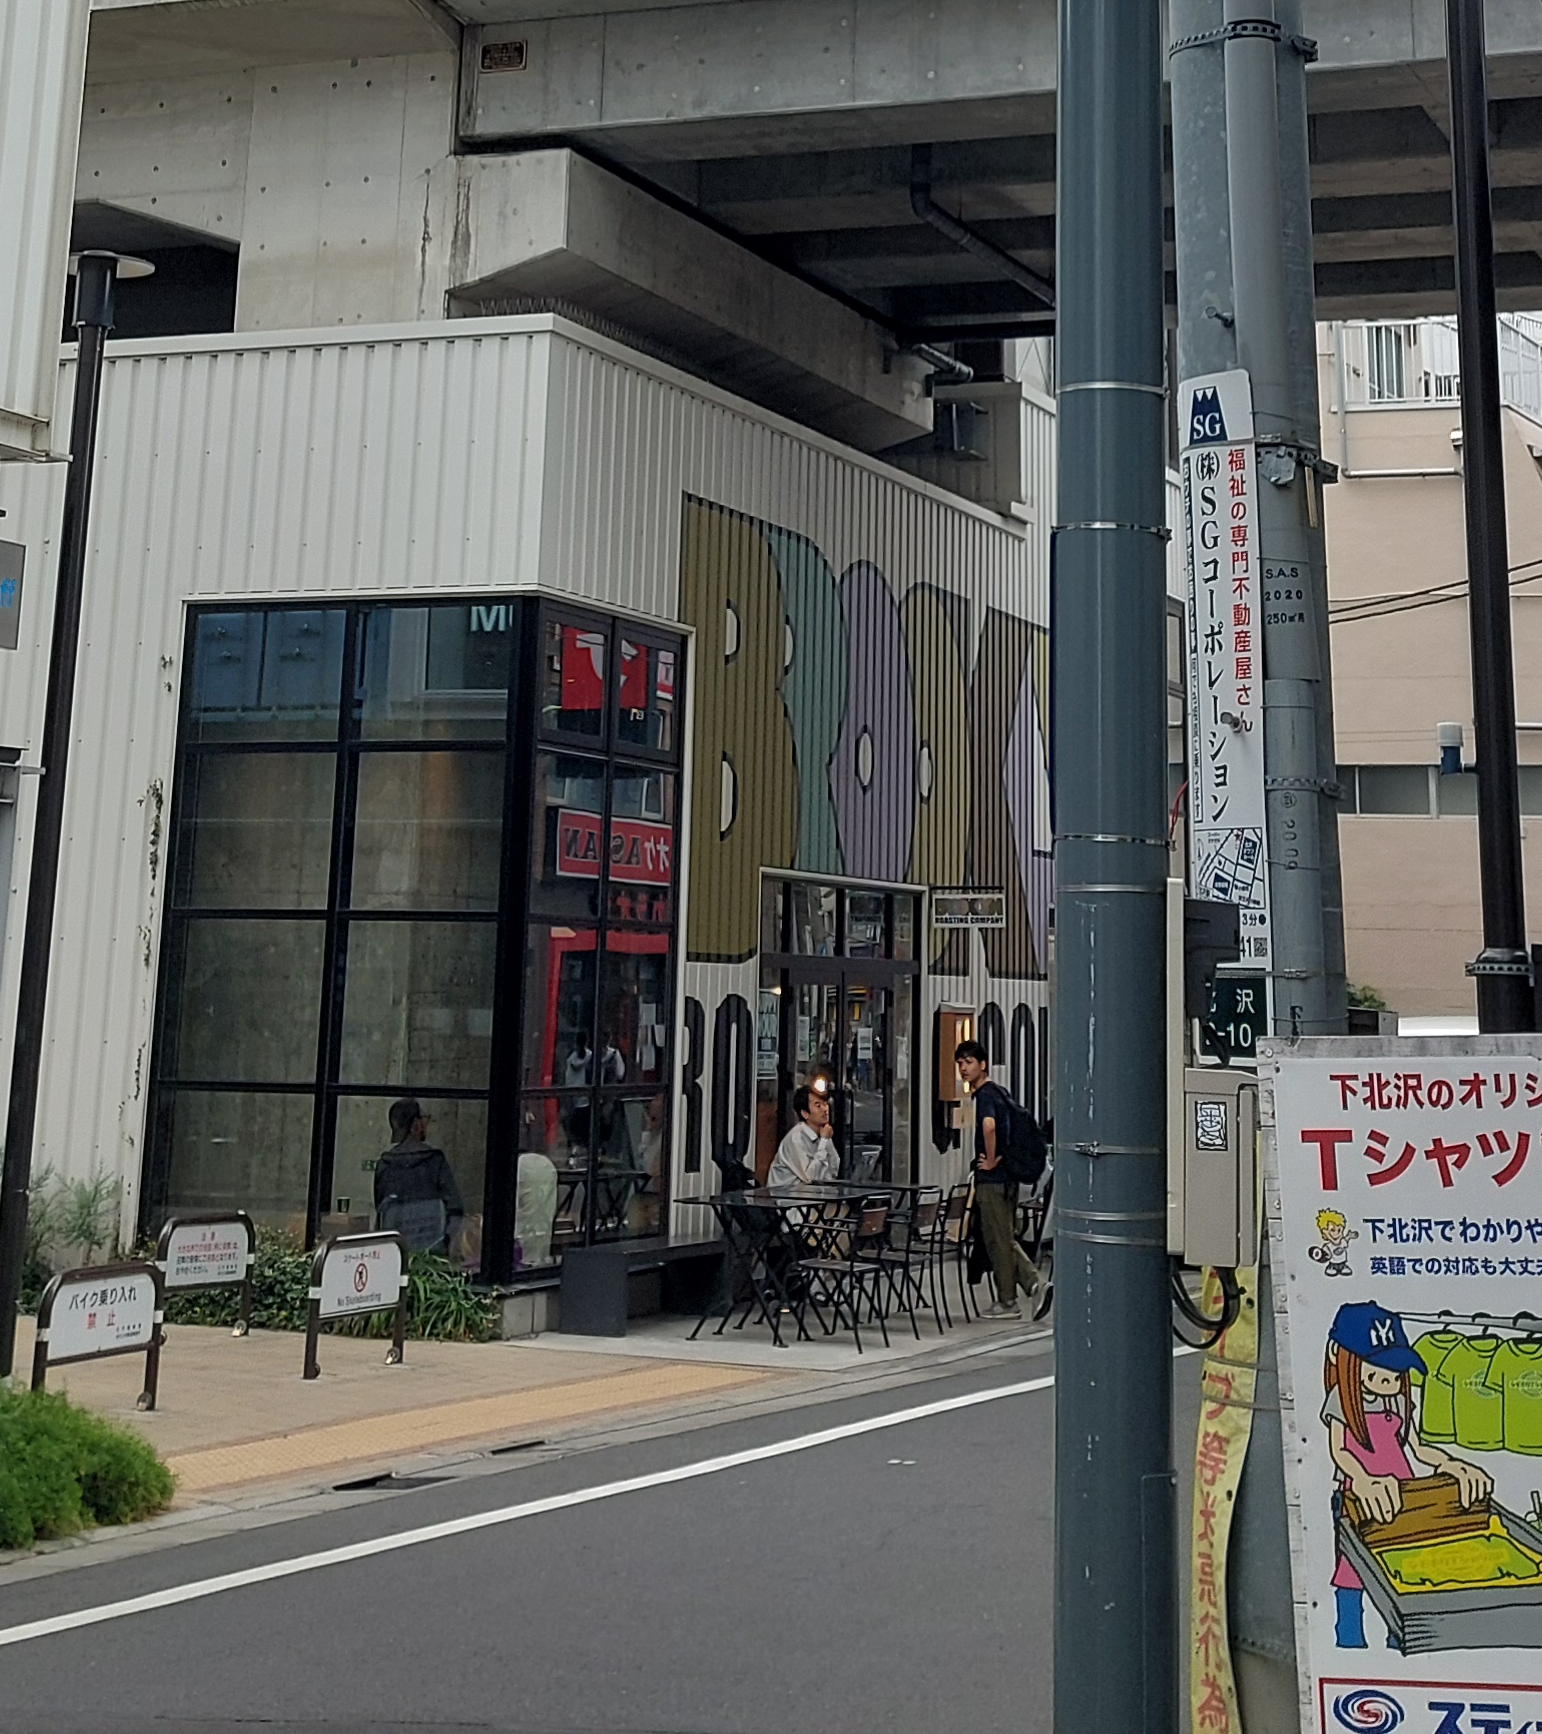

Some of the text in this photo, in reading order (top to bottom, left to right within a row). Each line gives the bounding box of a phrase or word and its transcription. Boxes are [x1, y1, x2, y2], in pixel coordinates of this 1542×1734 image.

[1193, 413, 1222, 440] SG
[1264, 589, 1303, 602] 2020
[68, 1285, 137, 1310] バイク乗り入れ
